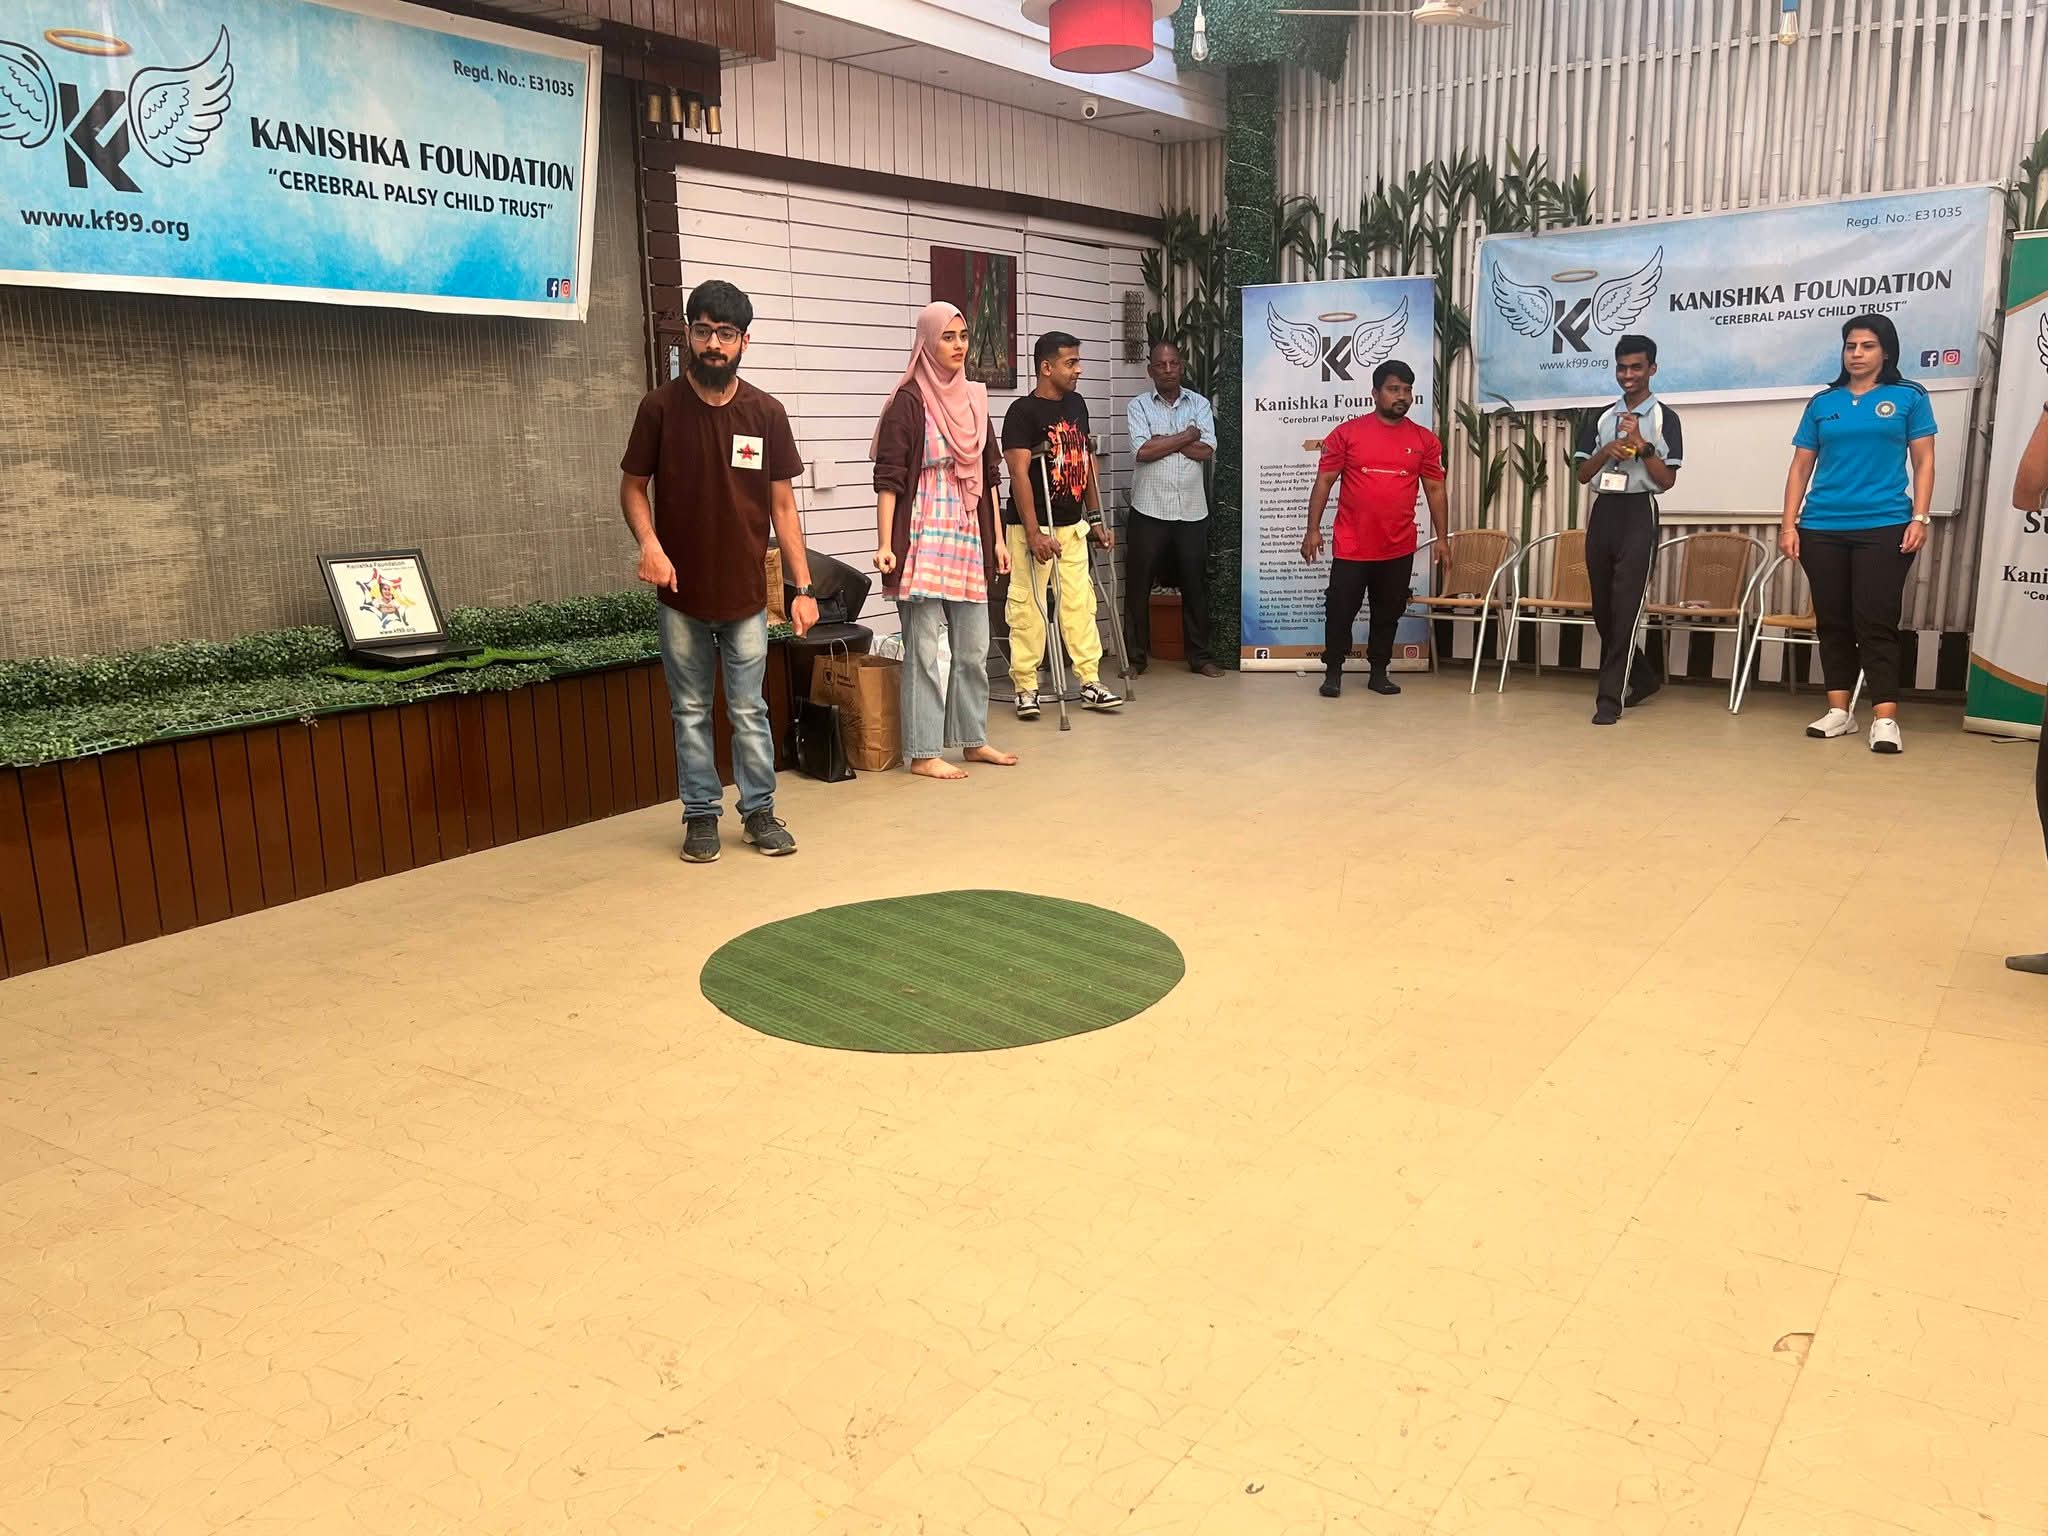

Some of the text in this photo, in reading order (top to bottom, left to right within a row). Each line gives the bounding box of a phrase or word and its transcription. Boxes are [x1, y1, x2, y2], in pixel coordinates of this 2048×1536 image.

[453, 59, 575, 97] Regd. No.: E31035
[250, 116, 575, 192] KANISHKA FOUNDATION
[268, 168, 553, 219] “CEREBRAL PALSY CHILD TRUST”
[20, 208, 190, 241] www.kf99.org
[1846, 206, 1963, 229] Regd. No.: E31035
[1669, 269, 1952, 312] KANISHKA FOUNDATION
[1709, 300, 1908, 326] “CEREBRAL PALSY CHILD TRUST”
[1539, 358, 1609, 370] www.kf99.org
[1255, 395, 1328, 412] Kanishka
[1321, 415, 1344, 424] Palsy
